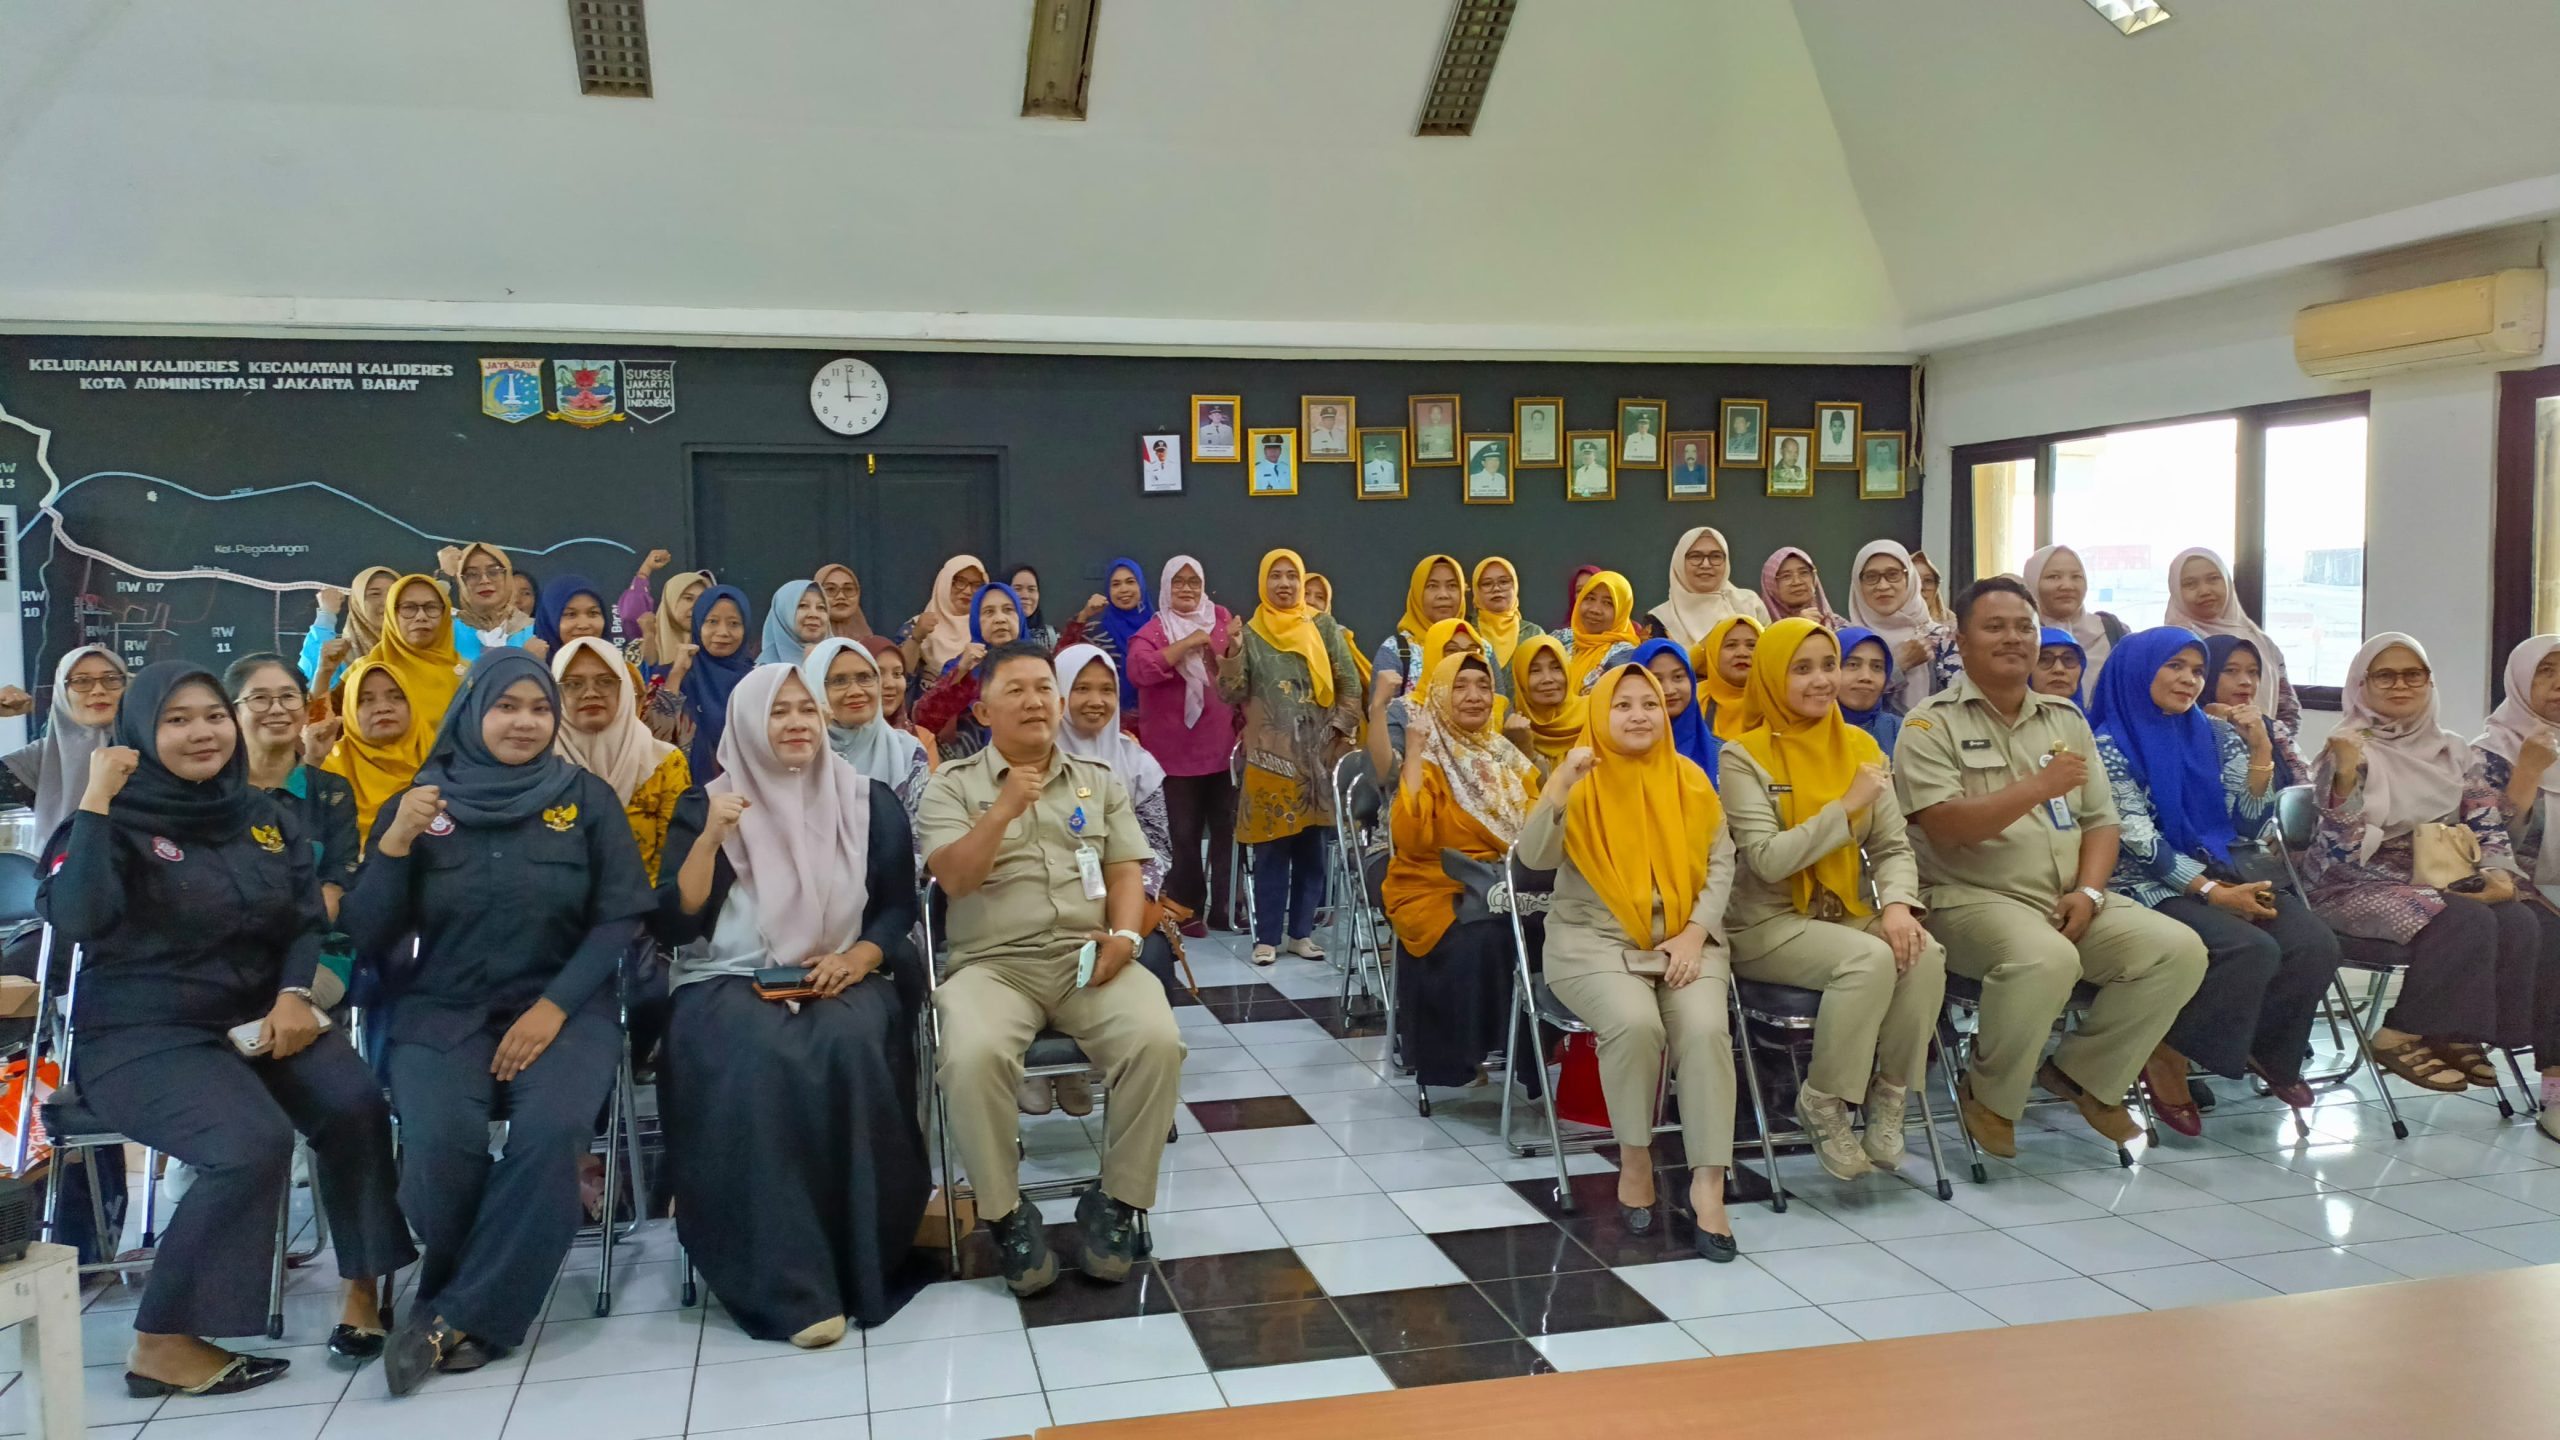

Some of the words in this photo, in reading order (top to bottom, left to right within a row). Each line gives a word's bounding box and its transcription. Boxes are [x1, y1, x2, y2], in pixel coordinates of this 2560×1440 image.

[29, 358, 138, 372] KELURAHAN
[140, 360, 240, 373] KALIDERES
[248, 361, 352, 374] KECAMATAN
[357, 363, 454, 376] KALIDERES
[626, 368, 671, 380] SUKSES
[832, 368, 840, 377] 11
[79, 377, 127, 390] KOTA
[134, 377, 266, 390] ADMINISTRASI
[272, 378, 354, 390] JAKARTA
[362, 378, 419, 391] BARAT
[626, 379, 671, 389] JAKARTA
[821, 378, 831, 387] 10
[871, 380, 877, 388] 2
[627, 389, 671, 399] UNTUK
[817, 391, 823, 399] 9
[876, 393, 882, 401] 3
[627, 398, 672, 408] INDONESIA
[822, 406, 829, 415] 8
[871, 407, 878, 415] 4
[833, 415, 839, 424] 7
[847, 420, 853, 429] 6
[861, 416, 868, 425] 5
[0, 462, 17, 473] W
[0, 478, 16, 489] 13
[116, 581, 141, 593] RW
[21, 590, 46, 602] RW
[23, 607, 41, 618] 10
[211, 625, 236, 638] RW
[124, 639, 148, 651] RW
[216, 642, 232, 653] 11
[127, 655, 144, 667] 16
